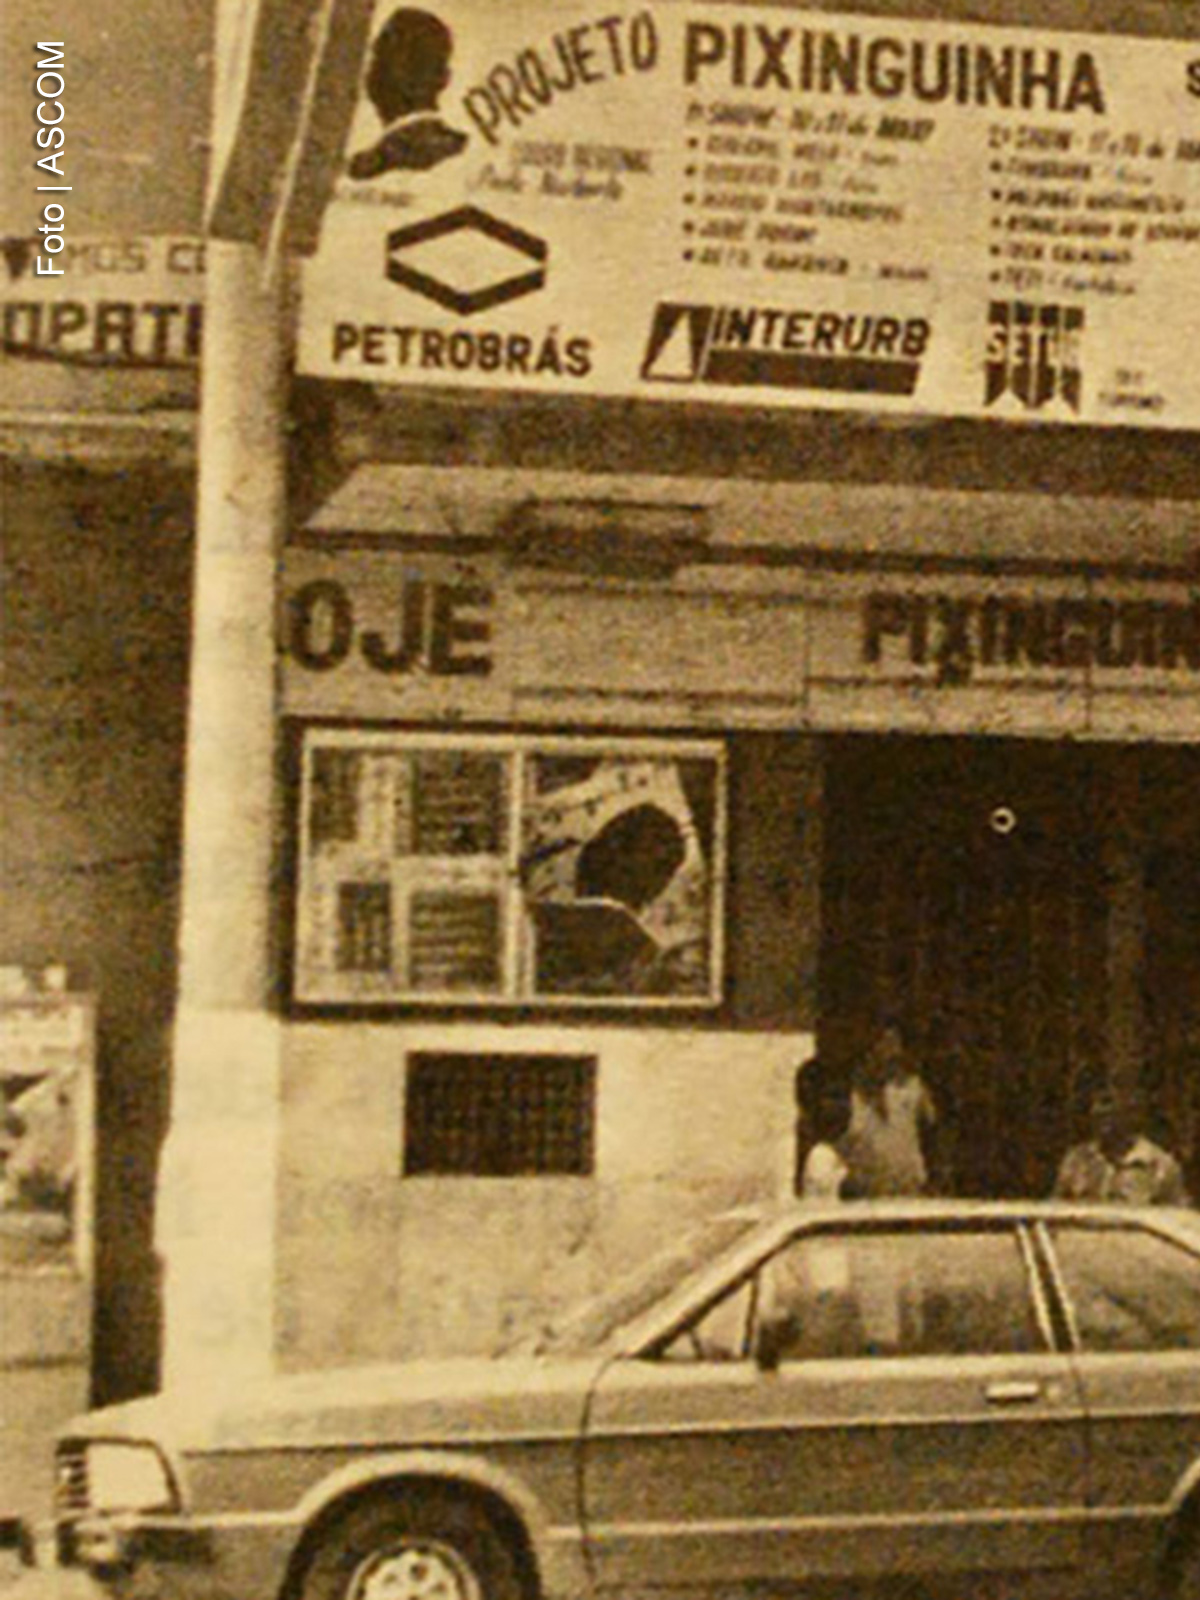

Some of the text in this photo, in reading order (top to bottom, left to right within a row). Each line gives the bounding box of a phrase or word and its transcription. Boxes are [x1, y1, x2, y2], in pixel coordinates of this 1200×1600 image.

[461, 10, 1105, 146] PROJETO PIXINGUINHA
[331, 324, 593, 378] PETROBRÁS
[712, 304, 931, 357] INTERURB
